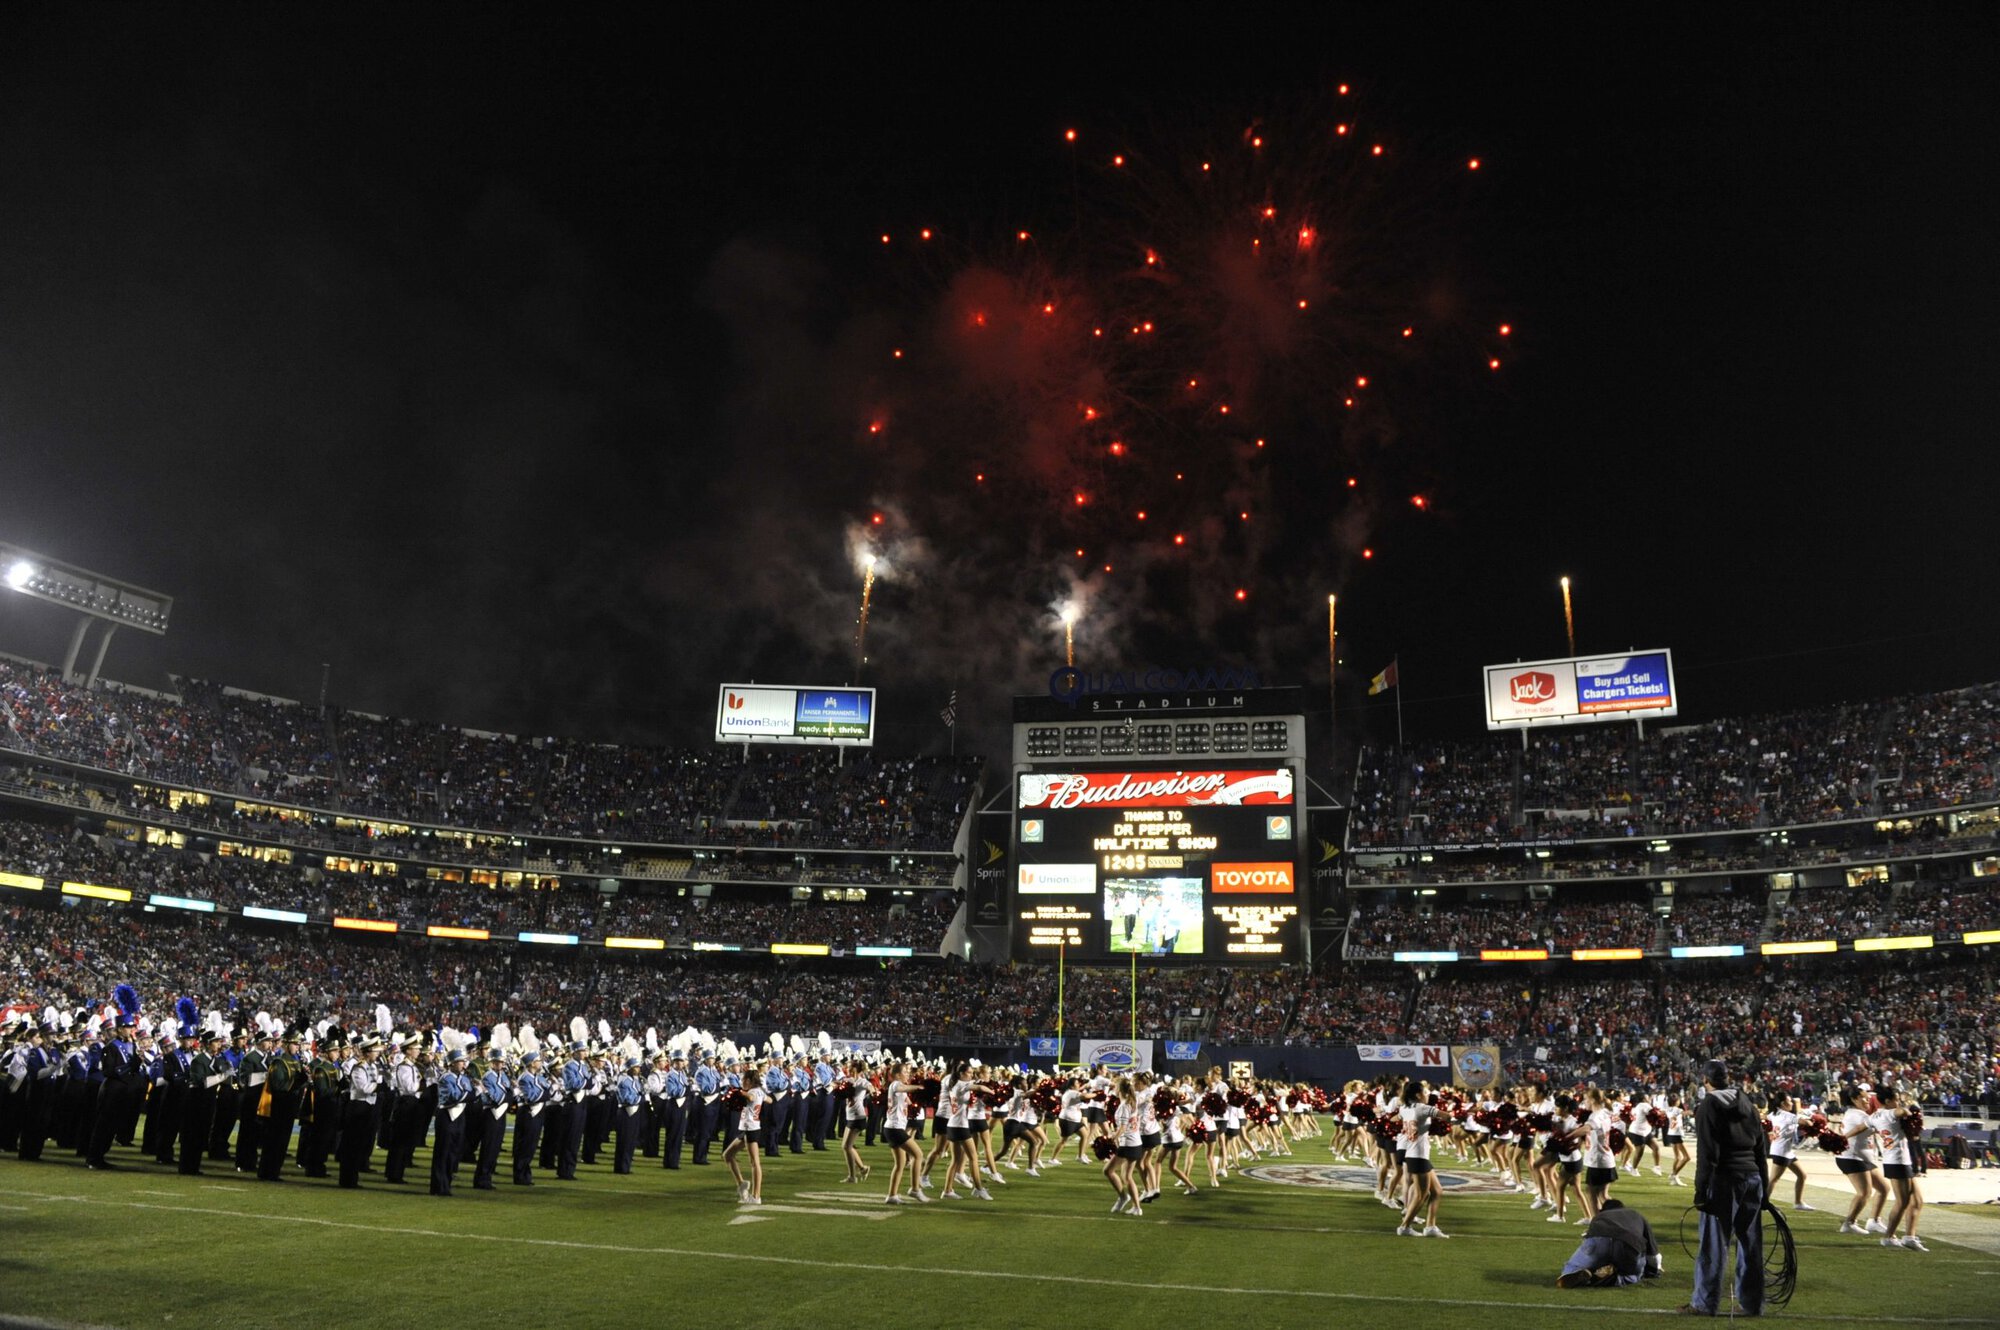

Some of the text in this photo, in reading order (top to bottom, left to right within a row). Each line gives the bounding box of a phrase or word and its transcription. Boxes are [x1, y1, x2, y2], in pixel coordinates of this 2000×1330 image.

[1594, 673, 1650, 688] Buy and Sell
[1512, 675, 1554, 701] Jack
[1583, 683, 1664, 700] Chargers Tickets!
[1093, 697, 1243, 709] STADIUM
[798, 725, 821, 734] ready.
[838, 726, 864, 734] thrive.
[1045, 771, 1225, 809] Budweiser
[1123, 811, 1183, 822] THANKS TO
[1114, 823, 1192, 836] DR PEPPER
[1094, 837, 1217, 850] HALFTIME SHOW
[976, 867, 1006, 880] Sprint
[1215, 870, 1291, 886] TOYOTA
[1312, 866, 1344, 878] Sprint
[1097, 1046, 1121, 1055] PACIFIC
[1422, 1048, 1441, 1065] N
[1232, 1062, 1250, 1077] 25
